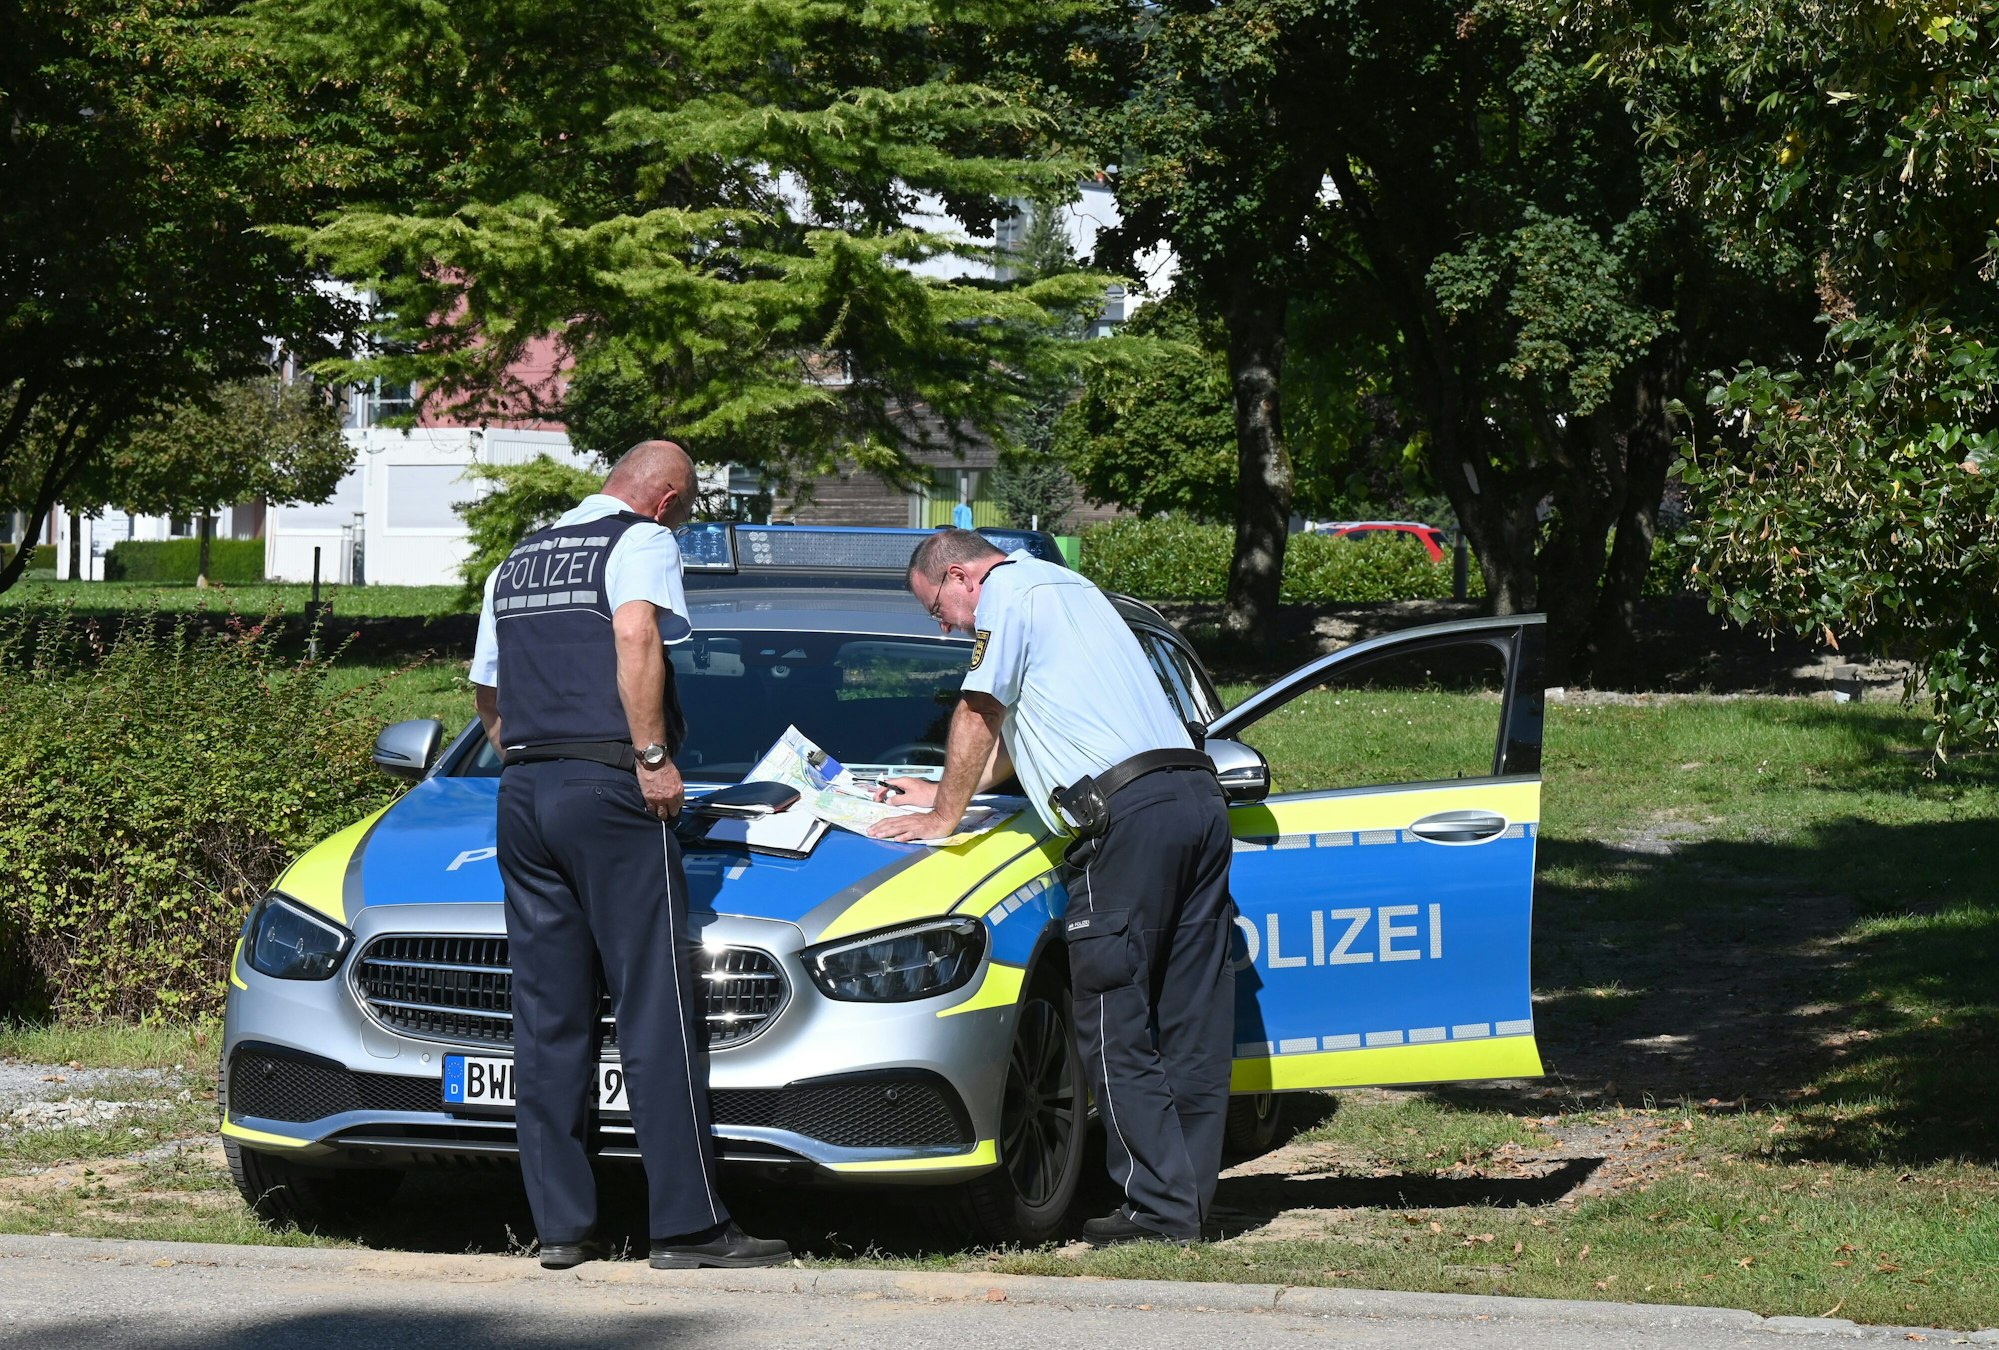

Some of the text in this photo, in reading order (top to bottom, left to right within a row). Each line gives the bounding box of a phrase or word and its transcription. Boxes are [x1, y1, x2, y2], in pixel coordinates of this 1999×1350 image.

[496, 551, 599, 593] POLIZEI
[1233, 903, 1442, 972] OLIZEI
[450, 1083, 459, 1095] D
